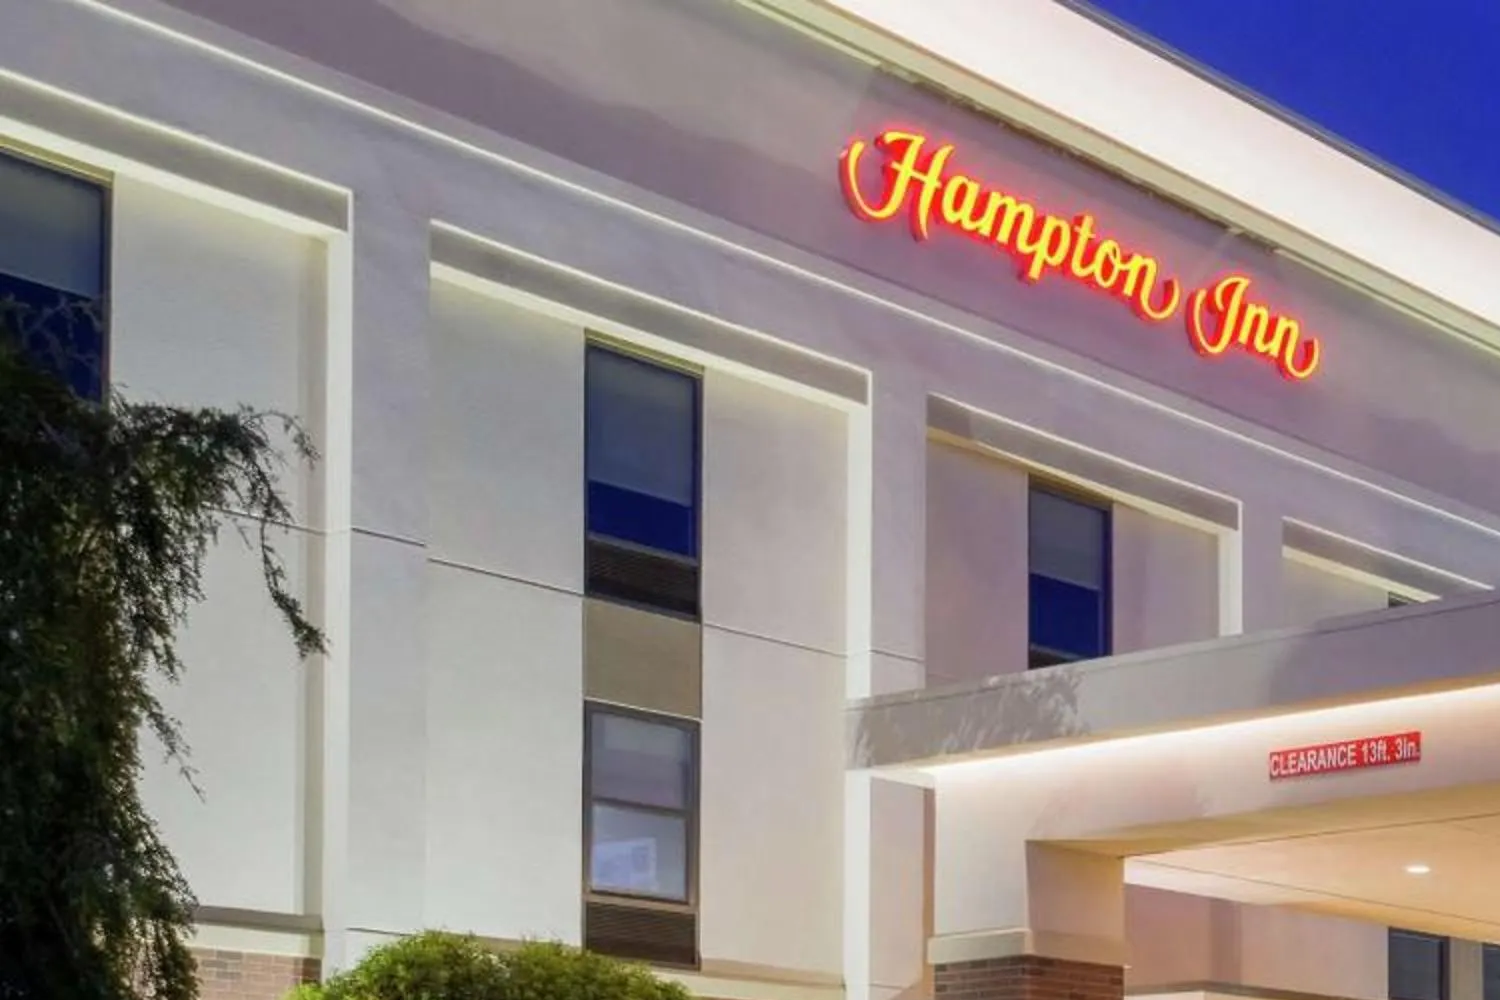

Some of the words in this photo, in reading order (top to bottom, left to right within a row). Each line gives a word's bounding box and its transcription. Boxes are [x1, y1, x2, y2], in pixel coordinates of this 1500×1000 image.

[839, 130, 1180, 321] Hampton
[1186, 274, 1319, 381] Inn
[1270, 744, 1357, 777] CLEARANCE
[1362, 739, 1390, 764] 13ft.
